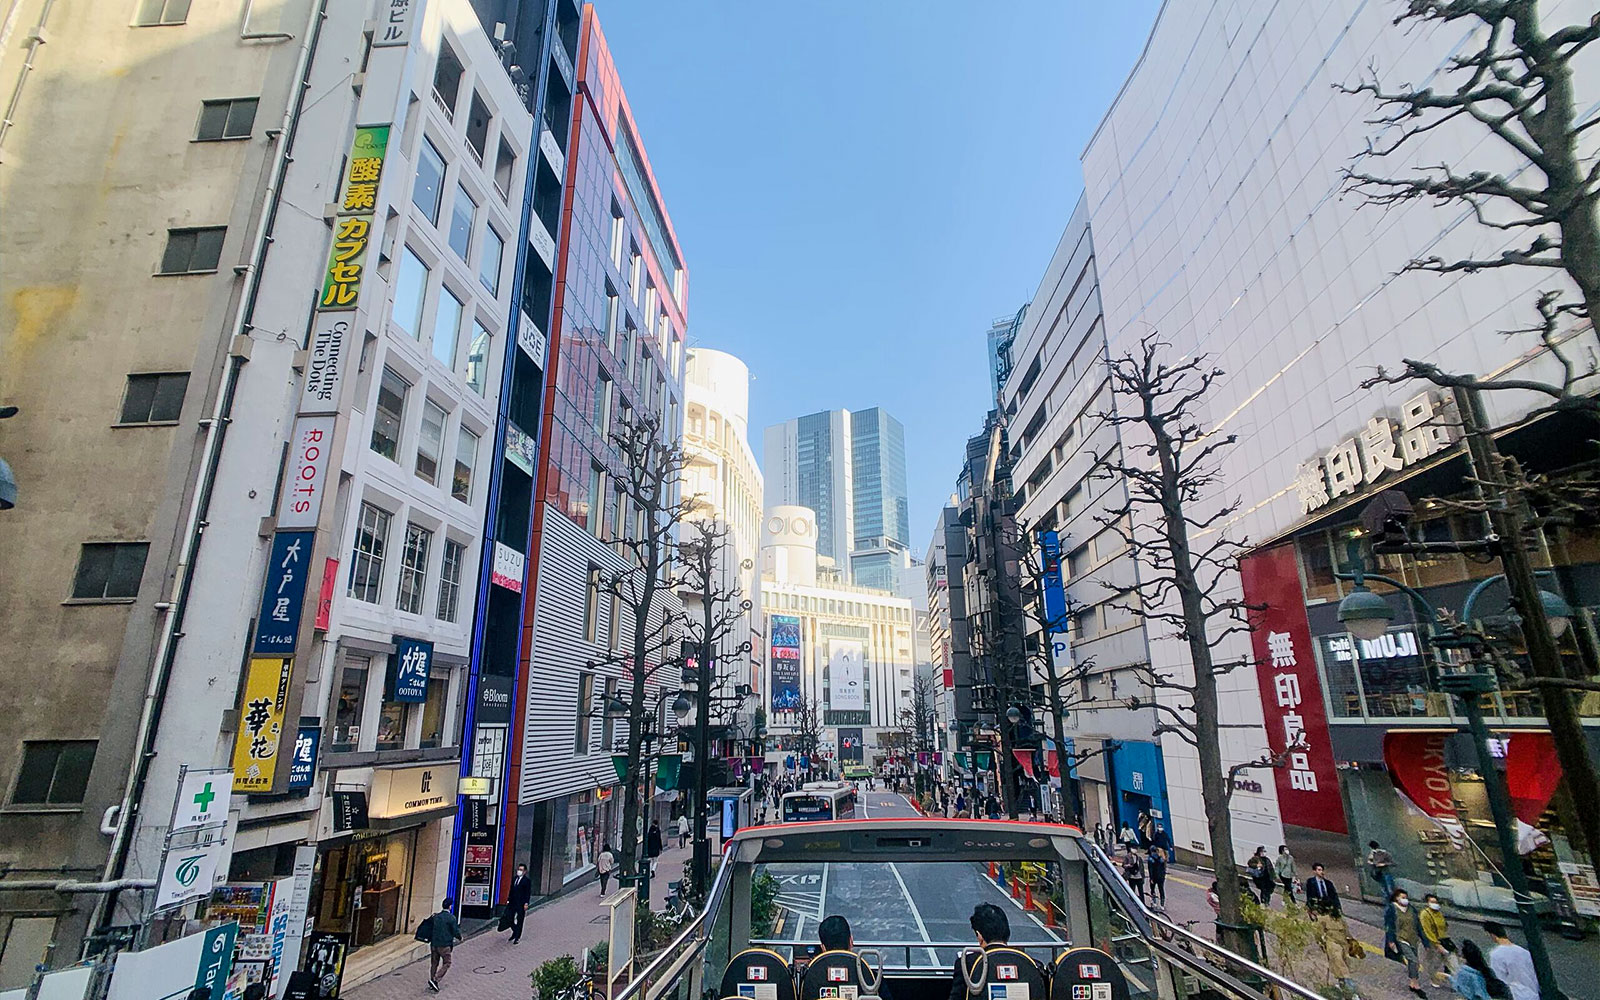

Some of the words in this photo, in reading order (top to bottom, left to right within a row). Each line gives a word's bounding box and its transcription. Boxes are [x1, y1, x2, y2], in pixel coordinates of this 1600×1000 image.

[323, 157, 382, 306] 酸素カプセル
[312, 329, 332, 357] The
[308, 357, 327, 392] Dots
[317, 321, 348, 400] Connecting
[1297, 391, 1451, 515] 無印良品
[498, 547, 521, 567] SUZU
[272, 538, 301, 621] 大戸屋
[1054, 642, 1066, 657] P
[1329, 638, 1350, 652] Café
[1361, 632, 1418, 660] MUJI
[399, 646, 427, 679] 大戸屋
[399, 688, 422, 697] OOTOYA
[489, 689, 508, 703] Bloom
[1268, 631, 1318, 792] 無印良品
[1233, 780, 1262, 793] ovida
[343, 795, 352, 829] ZENITH
[404, 799, 429, 809] COMMON
[1074, 986, 1091, 999] JCB
